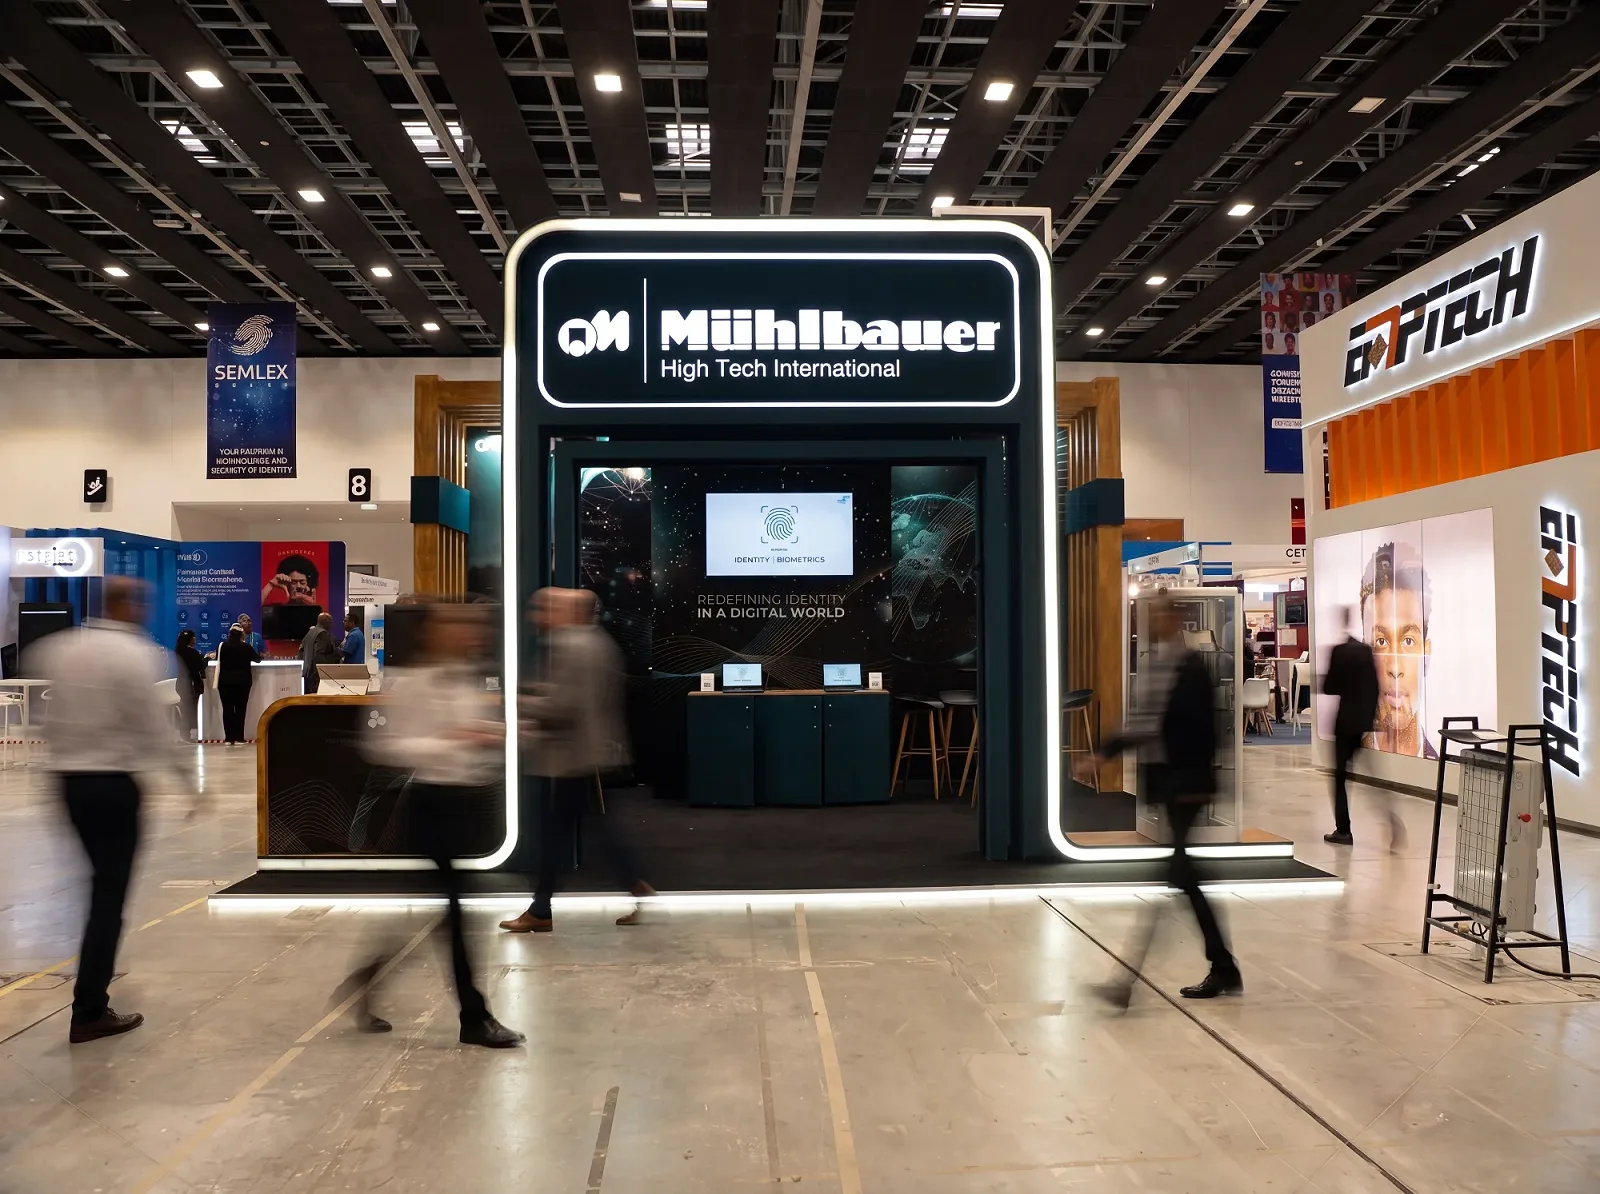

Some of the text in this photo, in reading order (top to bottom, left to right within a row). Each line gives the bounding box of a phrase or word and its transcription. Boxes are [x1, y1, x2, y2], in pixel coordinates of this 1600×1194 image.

[661, 309, 1000, 352] Mühlbauer
[214, 364, 288, 380] SEMLEX
[661, 359, 900, 382] High Tech International
[247, 466, 257, 474] OF
[259, 466, 293, 474] IDENTITY
[352, 475, 366, 496] 8
[697, 594, 846, 605] REDEFINING IDENTITY
[697, 607, 845, 618] IN A DIGITAL WORLD
